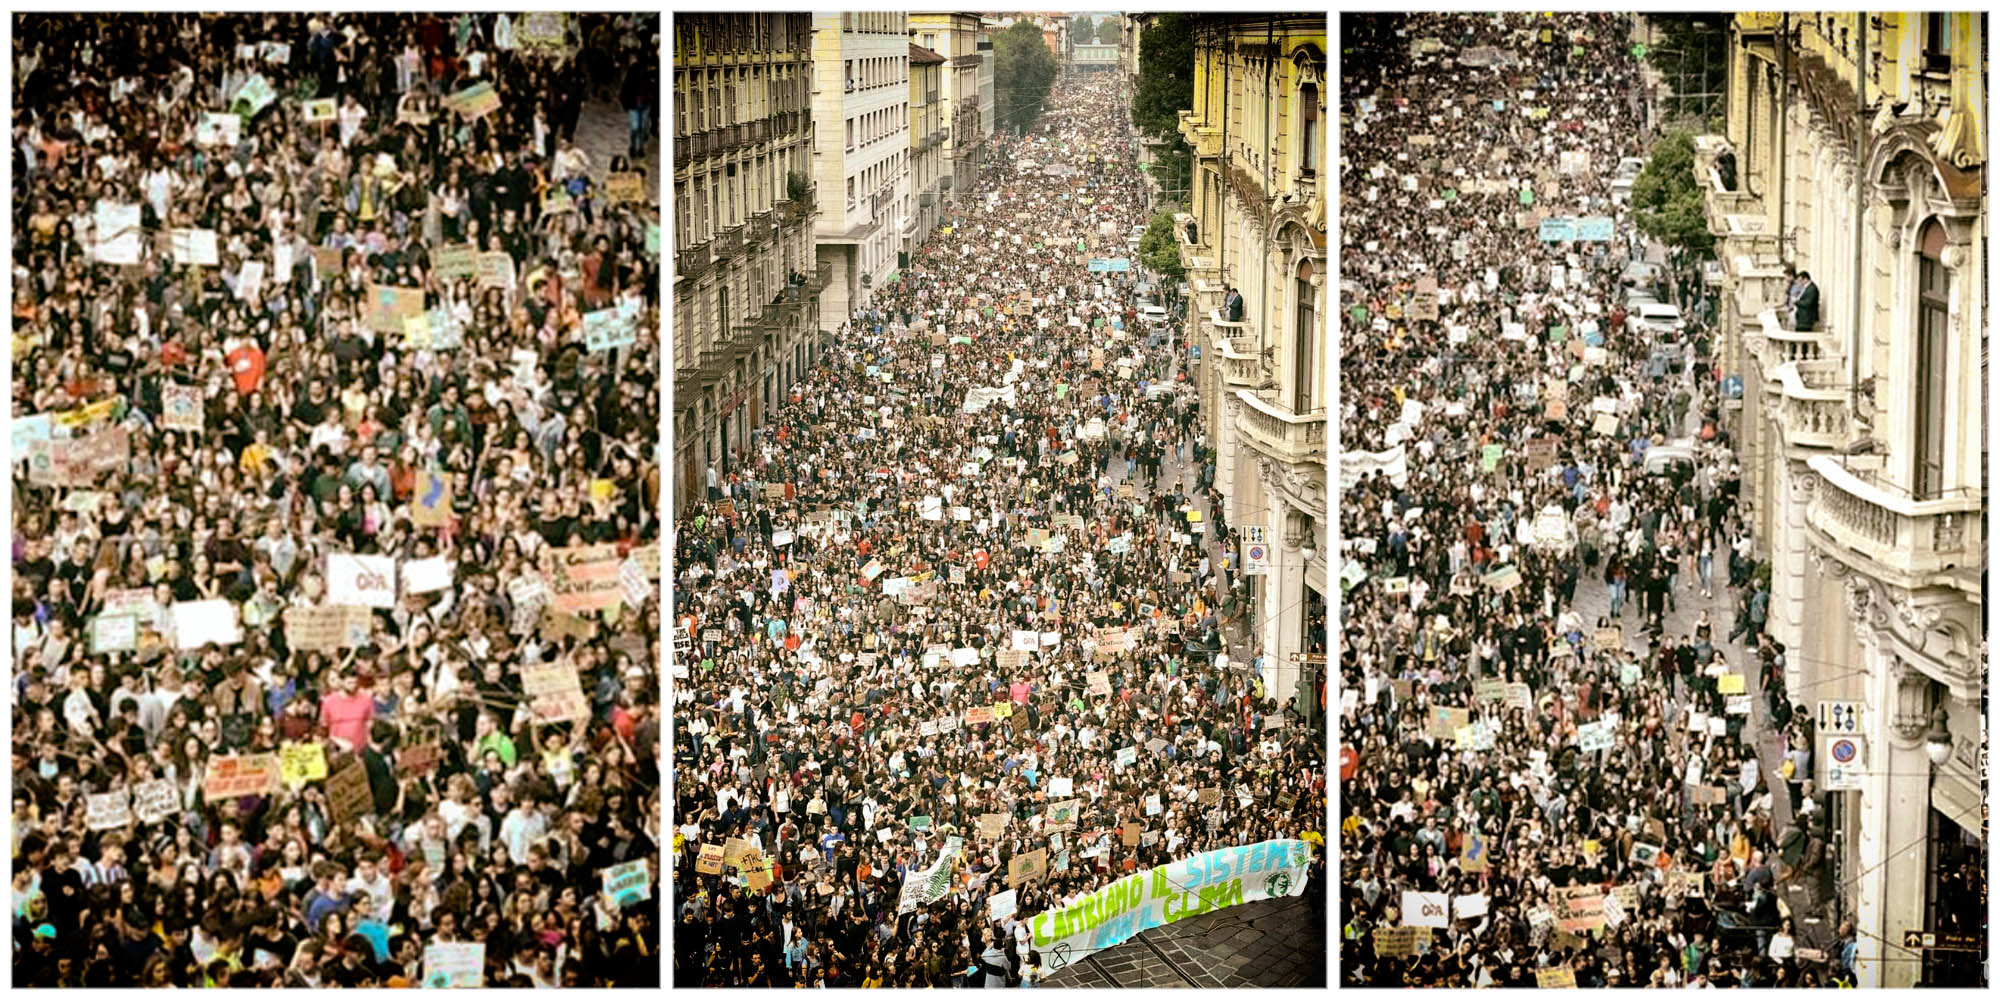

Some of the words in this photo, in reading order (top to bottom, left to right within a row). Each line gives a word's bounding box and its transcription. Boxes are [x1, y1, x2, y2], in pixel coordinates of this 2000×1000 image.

[1033, 874, 1144, 948] CAMBIAMO
[1152, 864, 1172, 899] IL
[1138, 904, 1162, 933] IL
[1163, 877, 1244, 924] CLIMA
